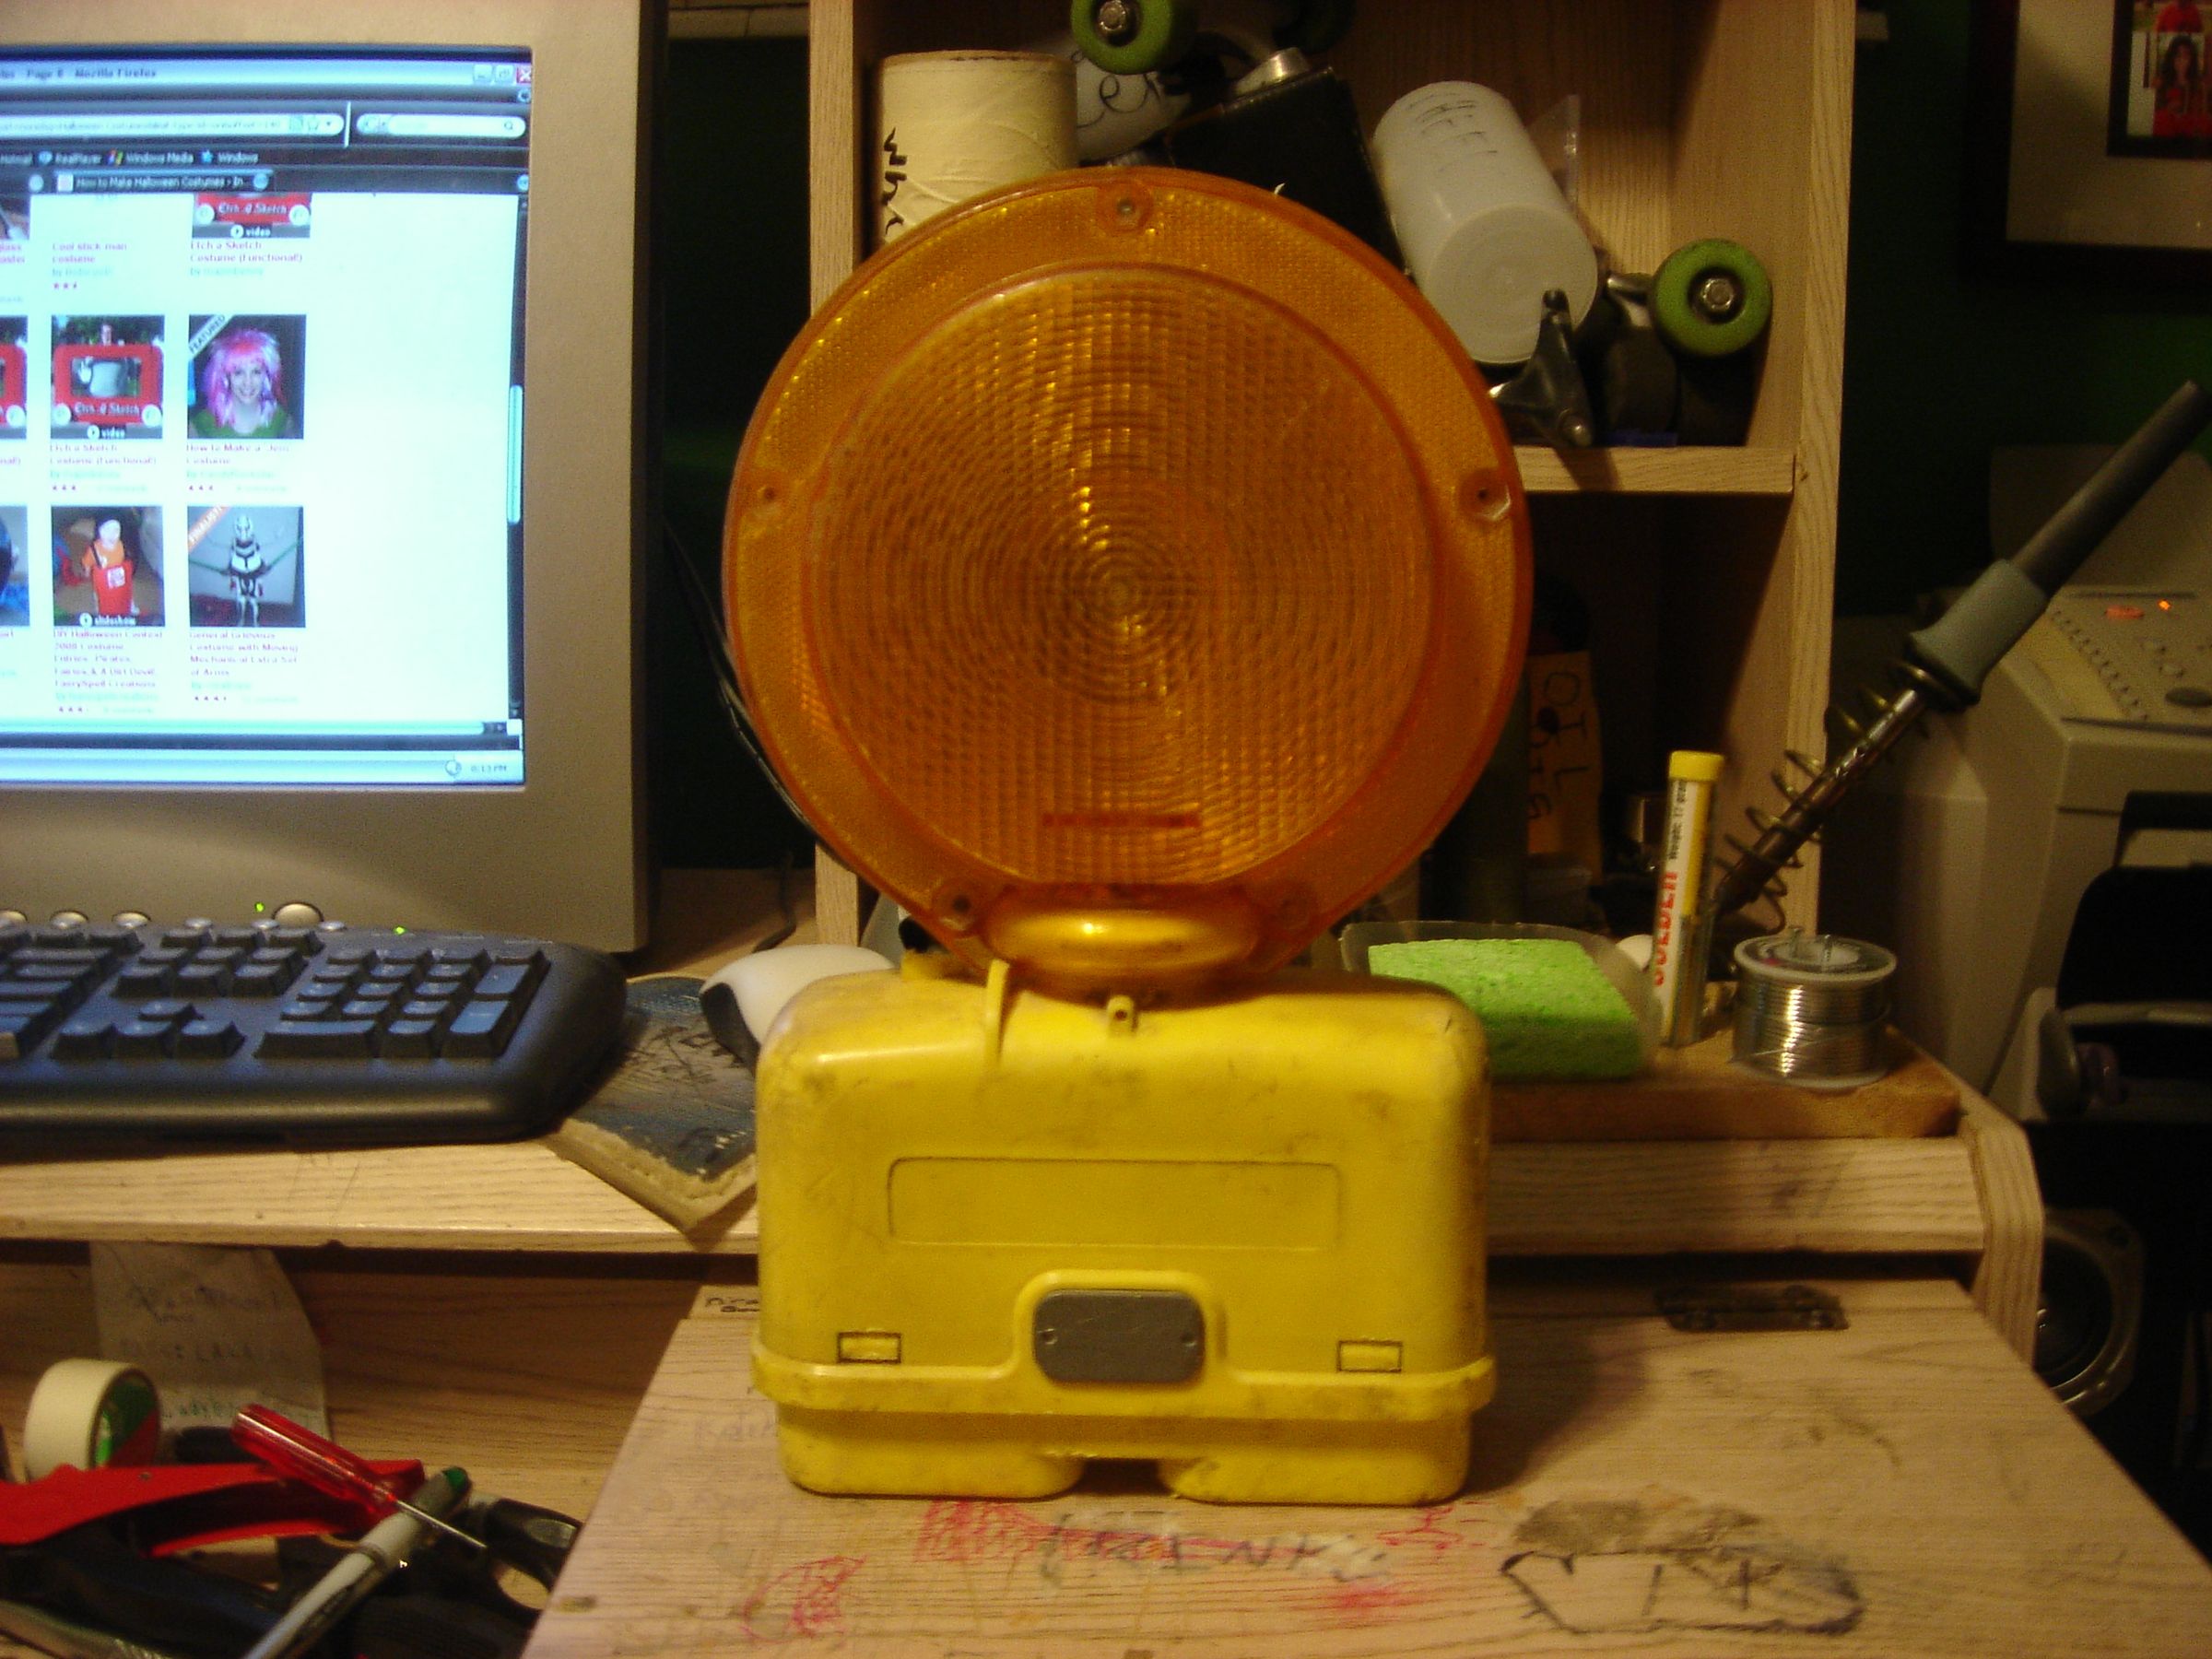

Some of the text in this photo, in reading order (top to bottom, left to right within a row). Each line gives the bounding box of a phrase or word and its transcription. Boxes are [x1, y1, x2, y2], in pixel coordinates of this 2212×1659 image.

[110, 176, 134, 187] Make
[135, 175, 180, 188] Halloween
[245, 226, 272, 238] video
[100, 428, 125, 441] video
[94, 614, 137, 627] slideshow
